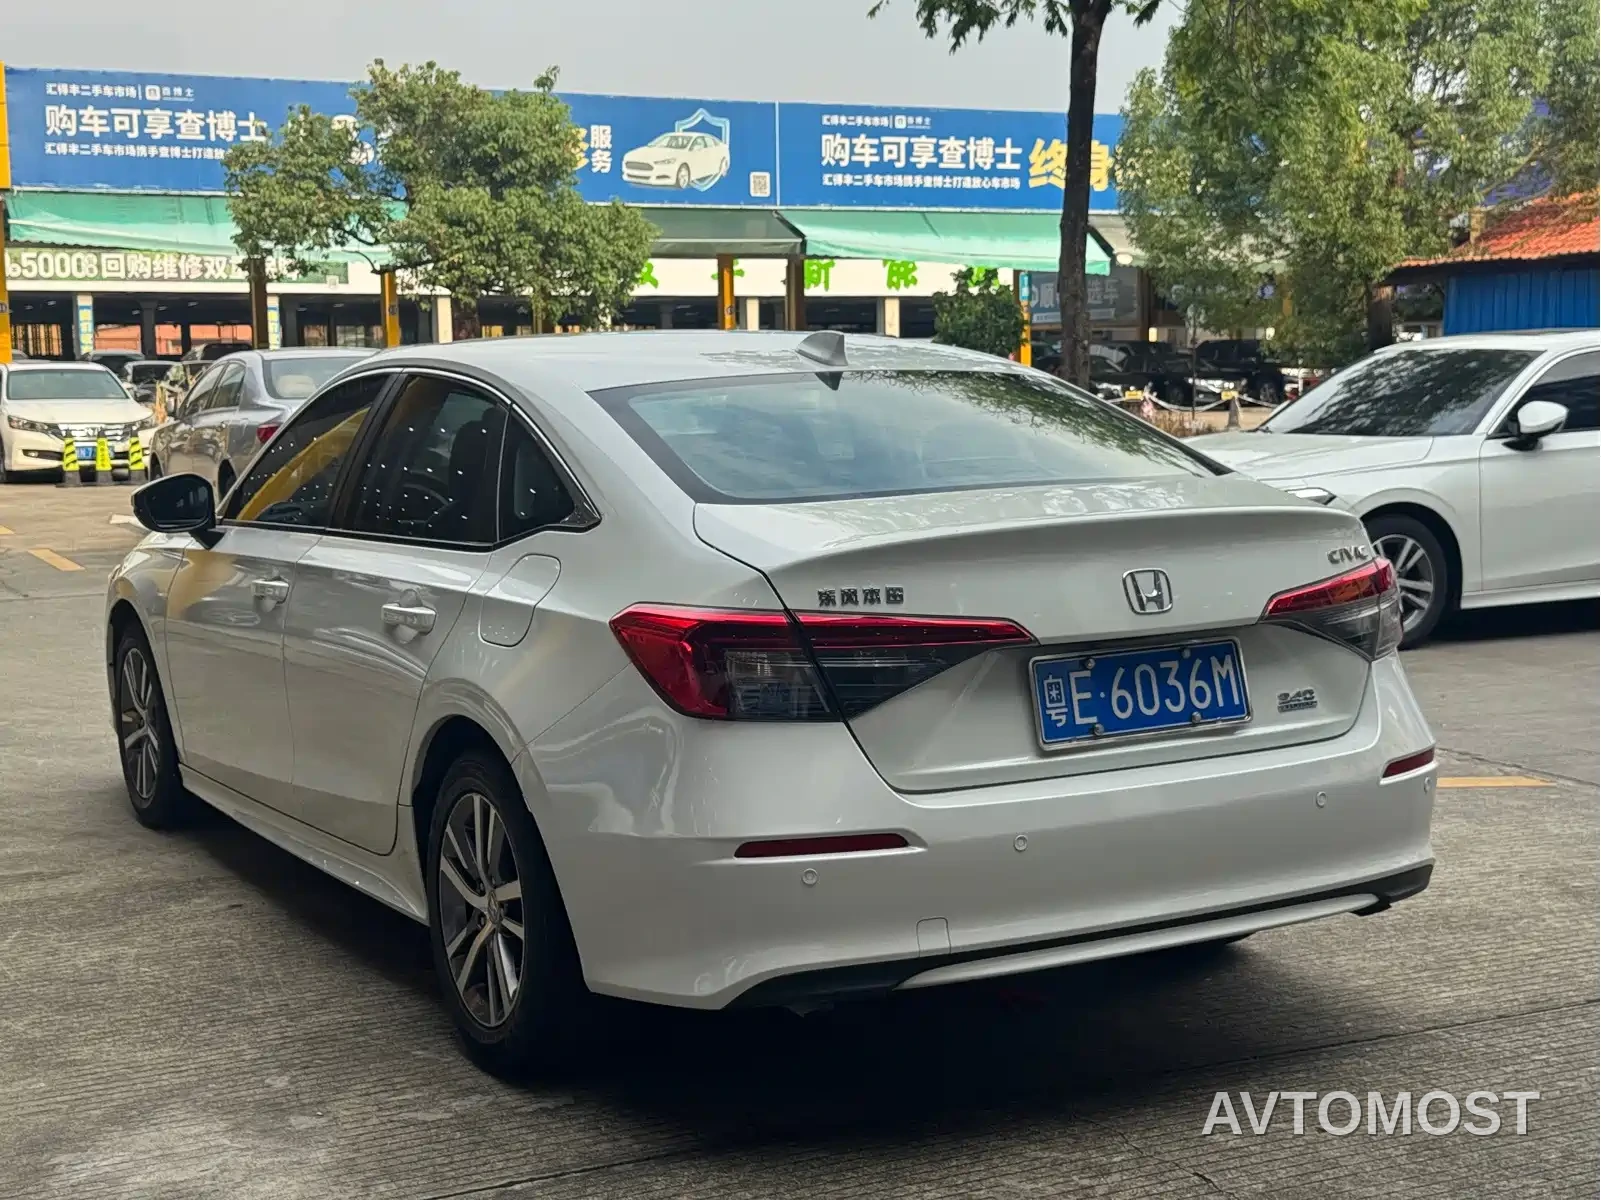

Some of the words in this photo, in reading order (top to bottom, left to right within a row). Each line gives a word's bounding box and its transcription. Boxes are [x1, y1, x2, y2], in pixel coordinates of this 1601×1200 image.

[45, 104, 267, 142] 购车可享查博士
[590, 124, 612, 173] 服务
[821, 133, 1023, 170] 购车可享查博士
[1327, 545, 1370, 565] CIVIC
[817, 585, 905, 607] 东风本田
